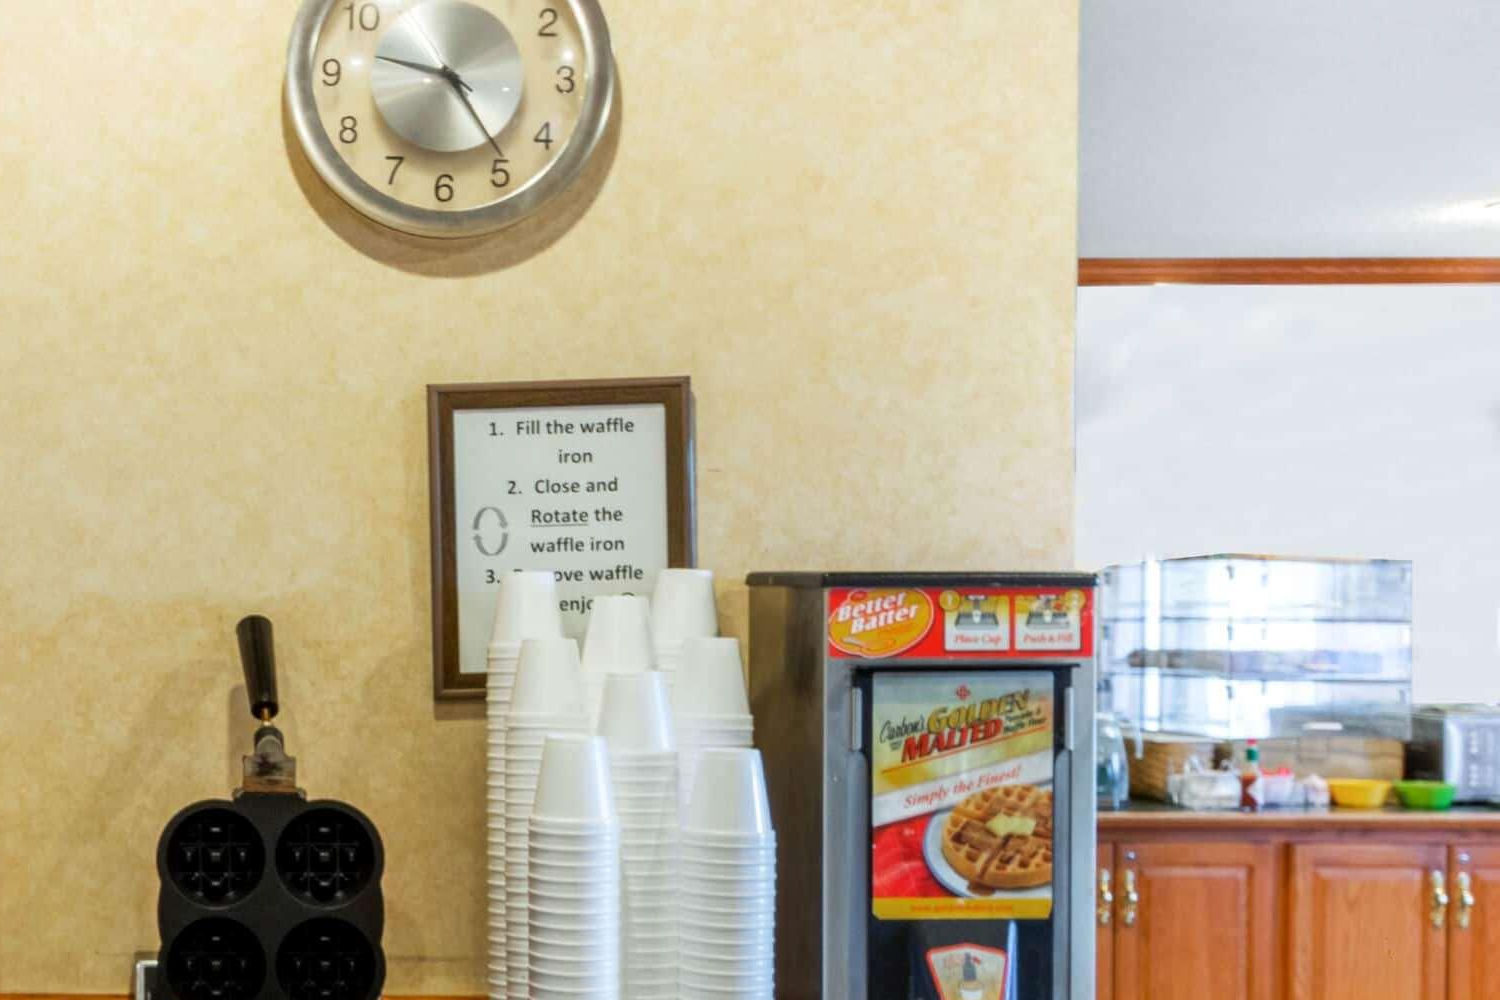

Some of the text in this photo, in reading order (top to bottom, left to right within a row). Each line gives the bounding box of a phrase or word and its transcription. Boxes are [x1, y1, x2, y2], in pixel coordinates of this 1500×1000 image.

[346, 3, 380, 31] 10
[538, 8, 558, 37] 2
[322, 58, 341, 87] 9
[556, 66, 575, 93] 3
[339, 115, 358, 144] 8
[533, 121, 554, 150] 4
[385, 156, 404, 185] 7
[490, 159, 510, 188] 5
[434, 174, 454, 202] 6
[489, 417, 635, 436] 1. Fill the waffle
[558, 449, 593, 464] iron
[507, 477, 619, 494] 2. Close and
[530, 507, 623, 525] Rotate the
[530, 537, 625, 553] waffle iron
[485, 569, 501, 584] 3.
[589, 565, 644, 581] waffle
[838, 592, 906, 622] Better
[851, 605, 918, 634] Batter
[902, 718, 1003, 763] MALTED
[903, 785, 949, 808] Simply
[953, 779, 973, 796] the
